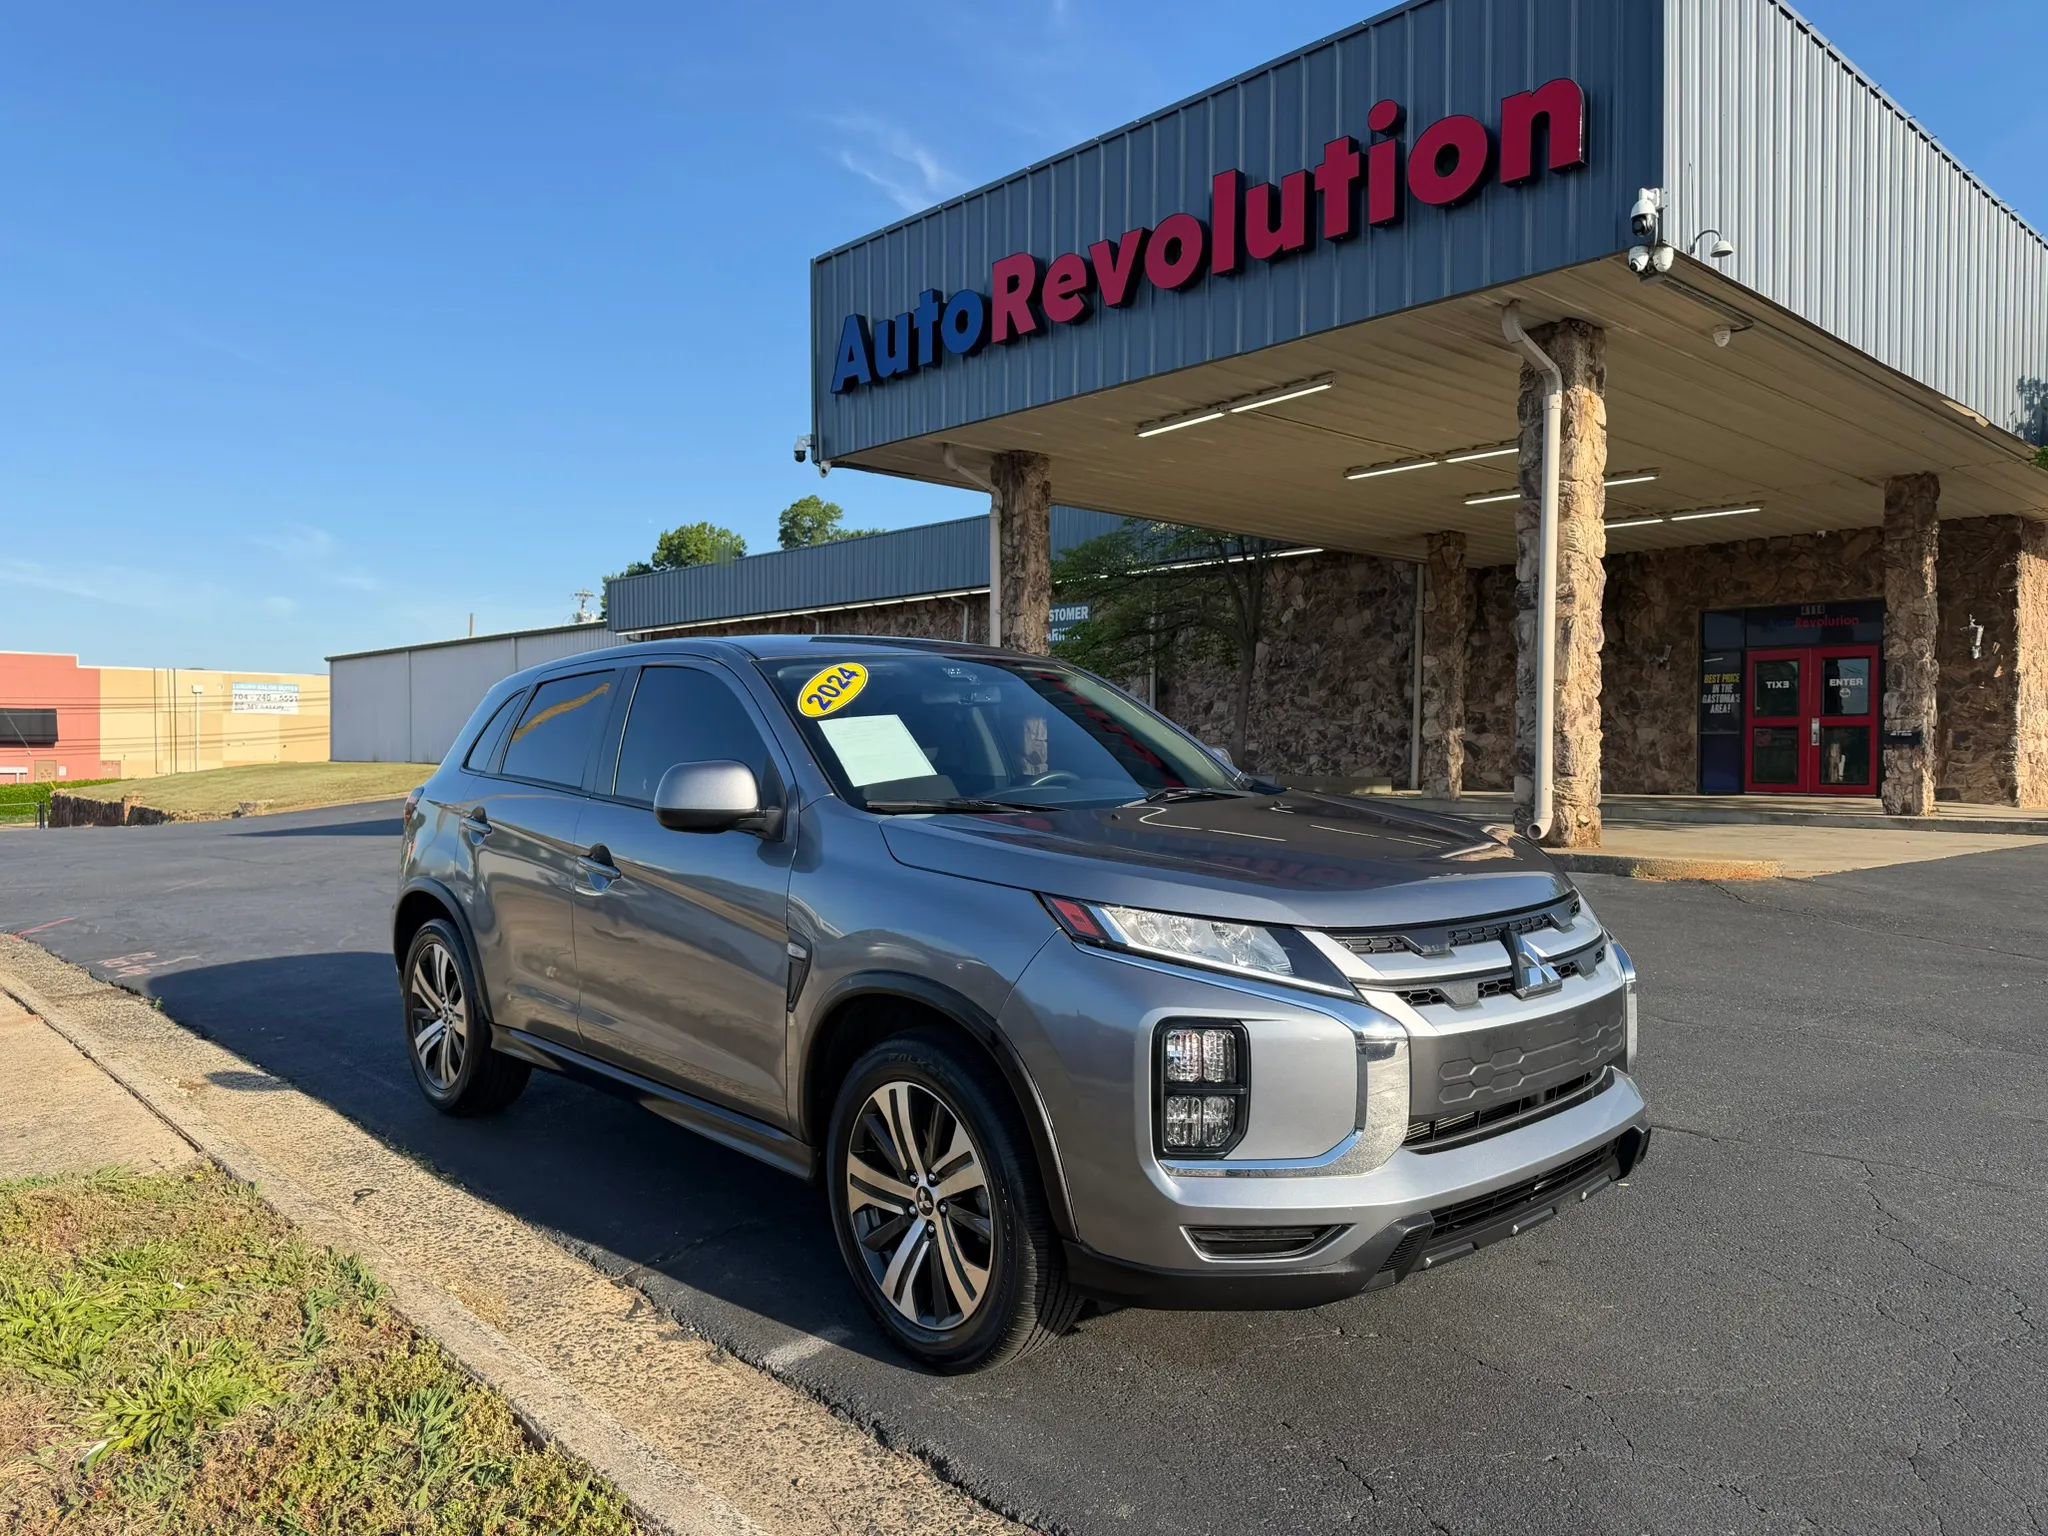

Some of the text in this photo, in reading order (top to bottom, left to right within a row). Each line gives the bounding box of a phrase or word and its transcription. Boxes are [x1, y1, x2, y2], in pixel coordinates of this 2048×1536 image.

[830, 78, 1588, 393] AutoRevolution
[1048, 606, 1089, 622] STOMER
[807, 667, 859, 711] 2024
[1721, 683, 1734, 694] THE
[1829, 678, 1864, 687] ENTER
